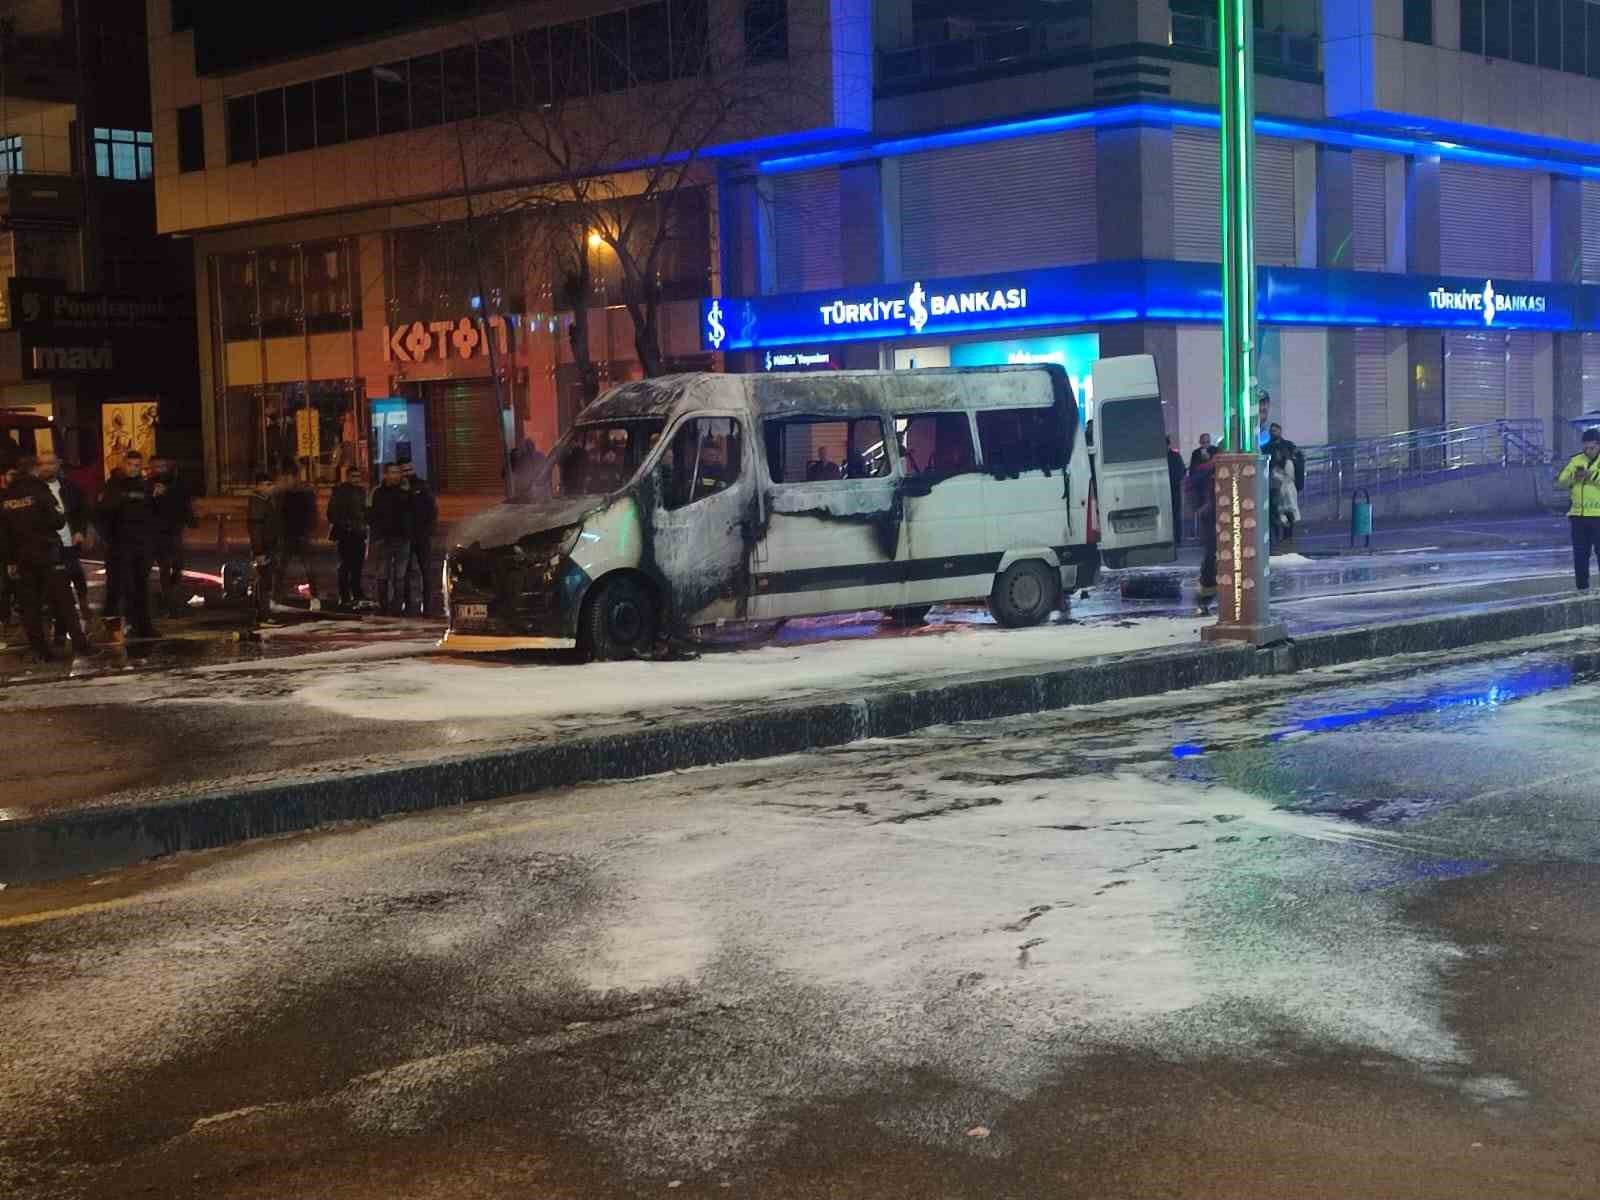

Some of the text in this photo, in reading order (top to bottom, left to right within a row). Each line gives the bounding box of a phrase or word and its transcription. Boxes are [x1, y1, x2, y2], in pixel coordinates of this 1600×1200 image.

[820, 297, 906, 325] TÜRKİYE
[930, 288, 1027, 315] BANKASI
[1428, 287, 1482, 310] TÜRKİYE
[1495, 294, 1545, 312] BANKASI
[32, 338, 113, 369] mavi
